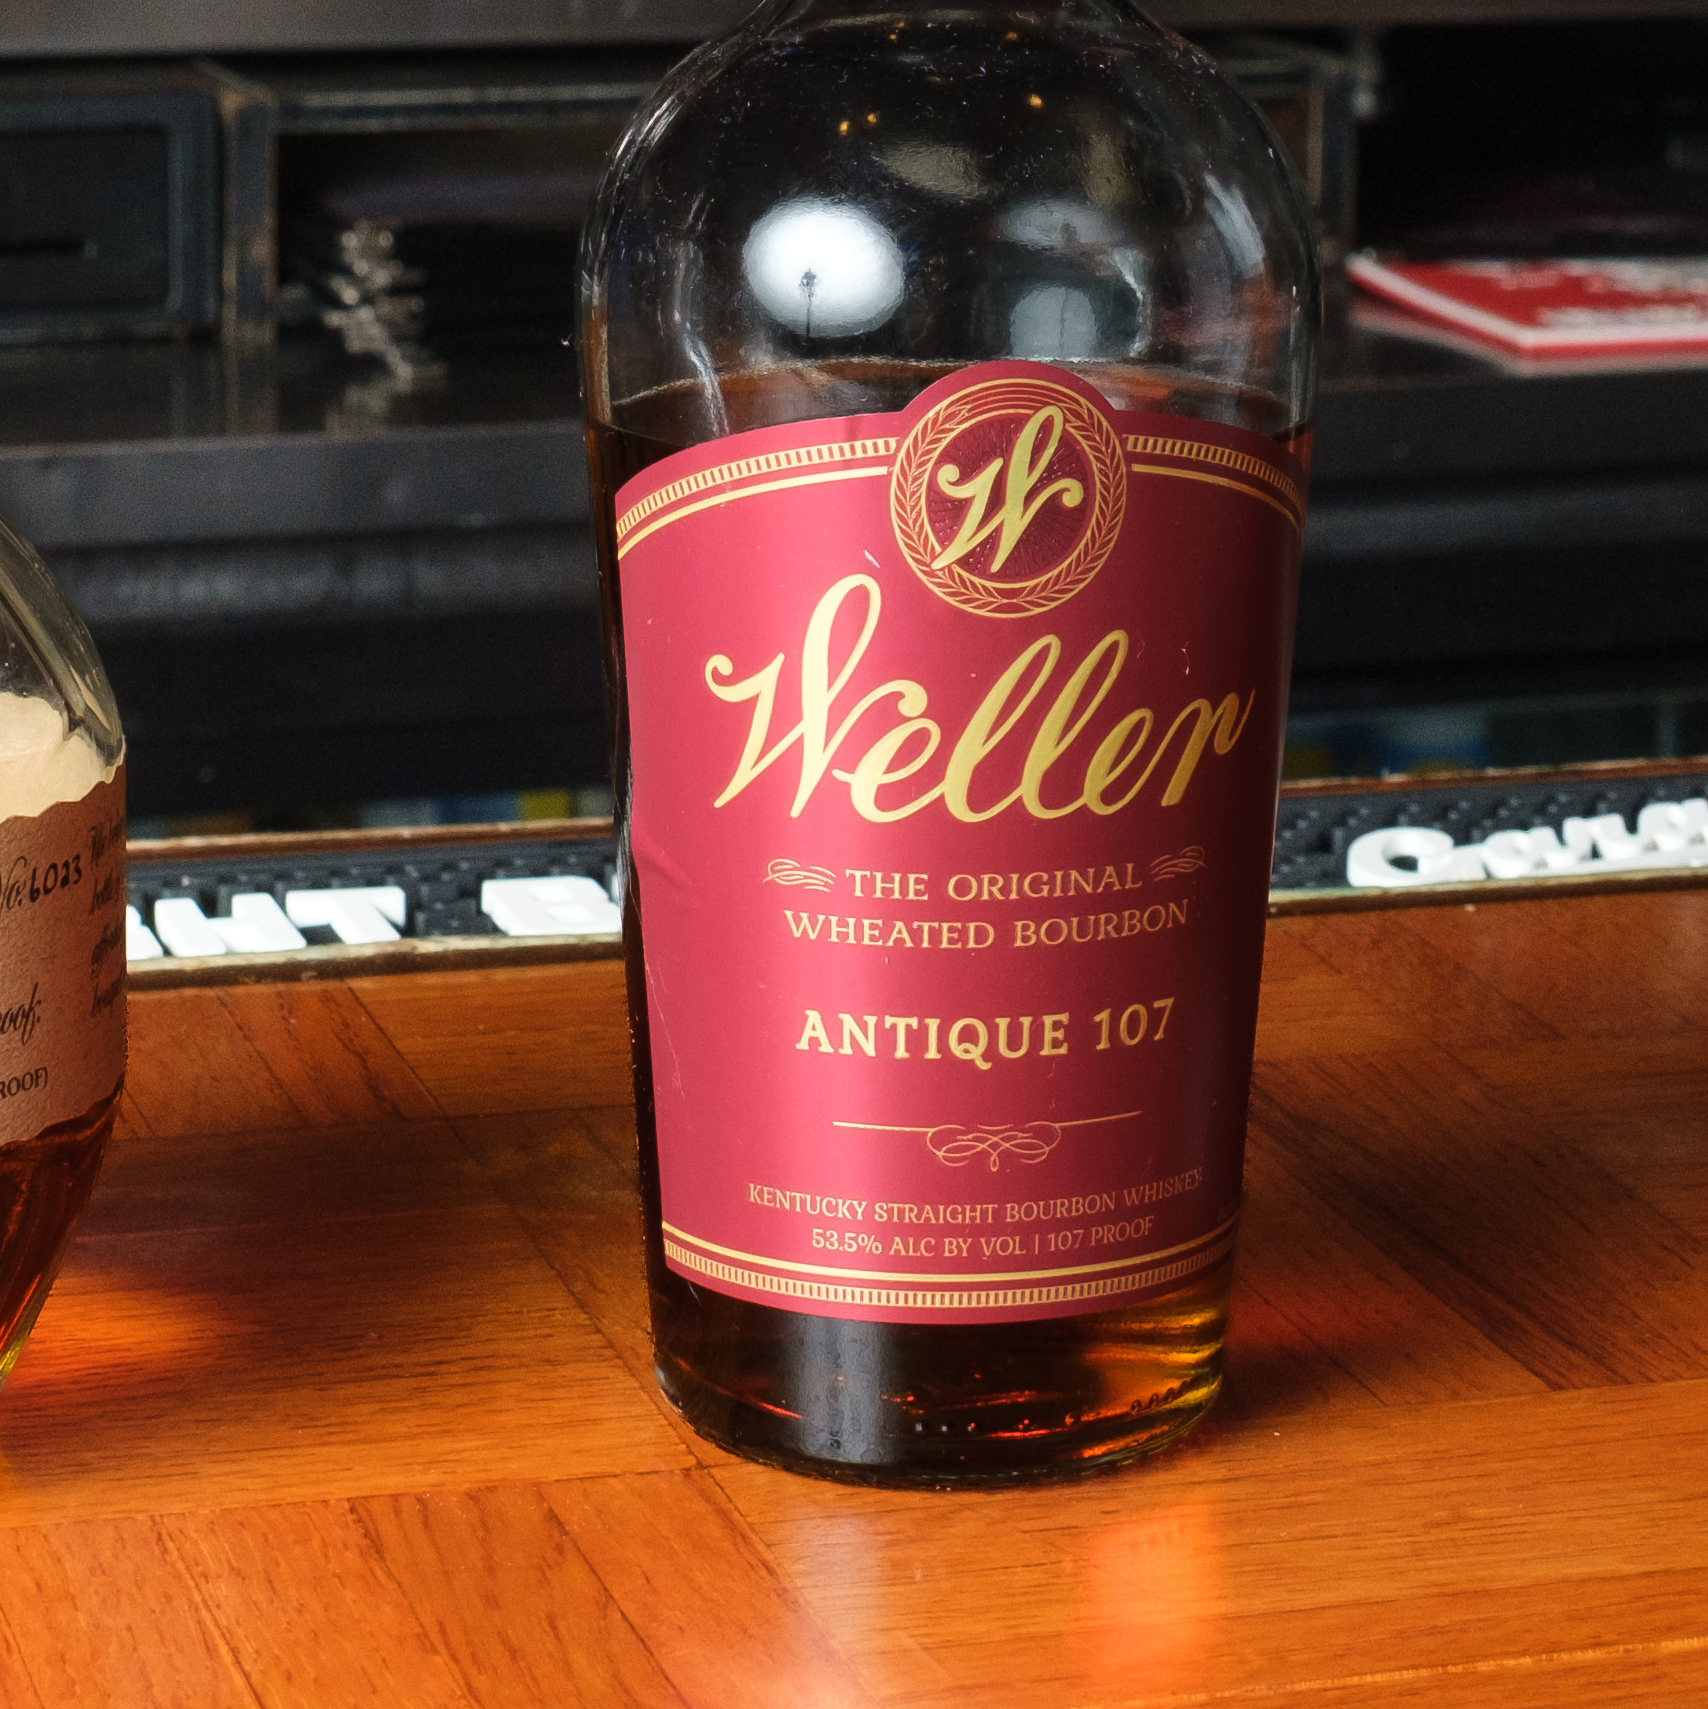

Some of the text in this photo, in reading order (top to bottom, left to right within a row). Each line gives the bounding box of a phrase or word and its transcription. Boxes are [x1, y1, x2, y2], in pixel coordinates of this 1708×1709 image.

[931, 405, 1083, 573] W
[704, 573, 1257, 824] Weller
[846, 862, 1143, 902] THE ORIGINAL
[783, 898, 1189, 950] WHEATED BOURBON
[795, 996, 1175, 1071] ANTIQUE 107
[748, 1166, 1205, 1225] KENTUCKY STRAIGHT BOURBON WHISKEY
[811, 1214, 1156, 1259] 53.5% ALC BY VOL 107 PROOF
